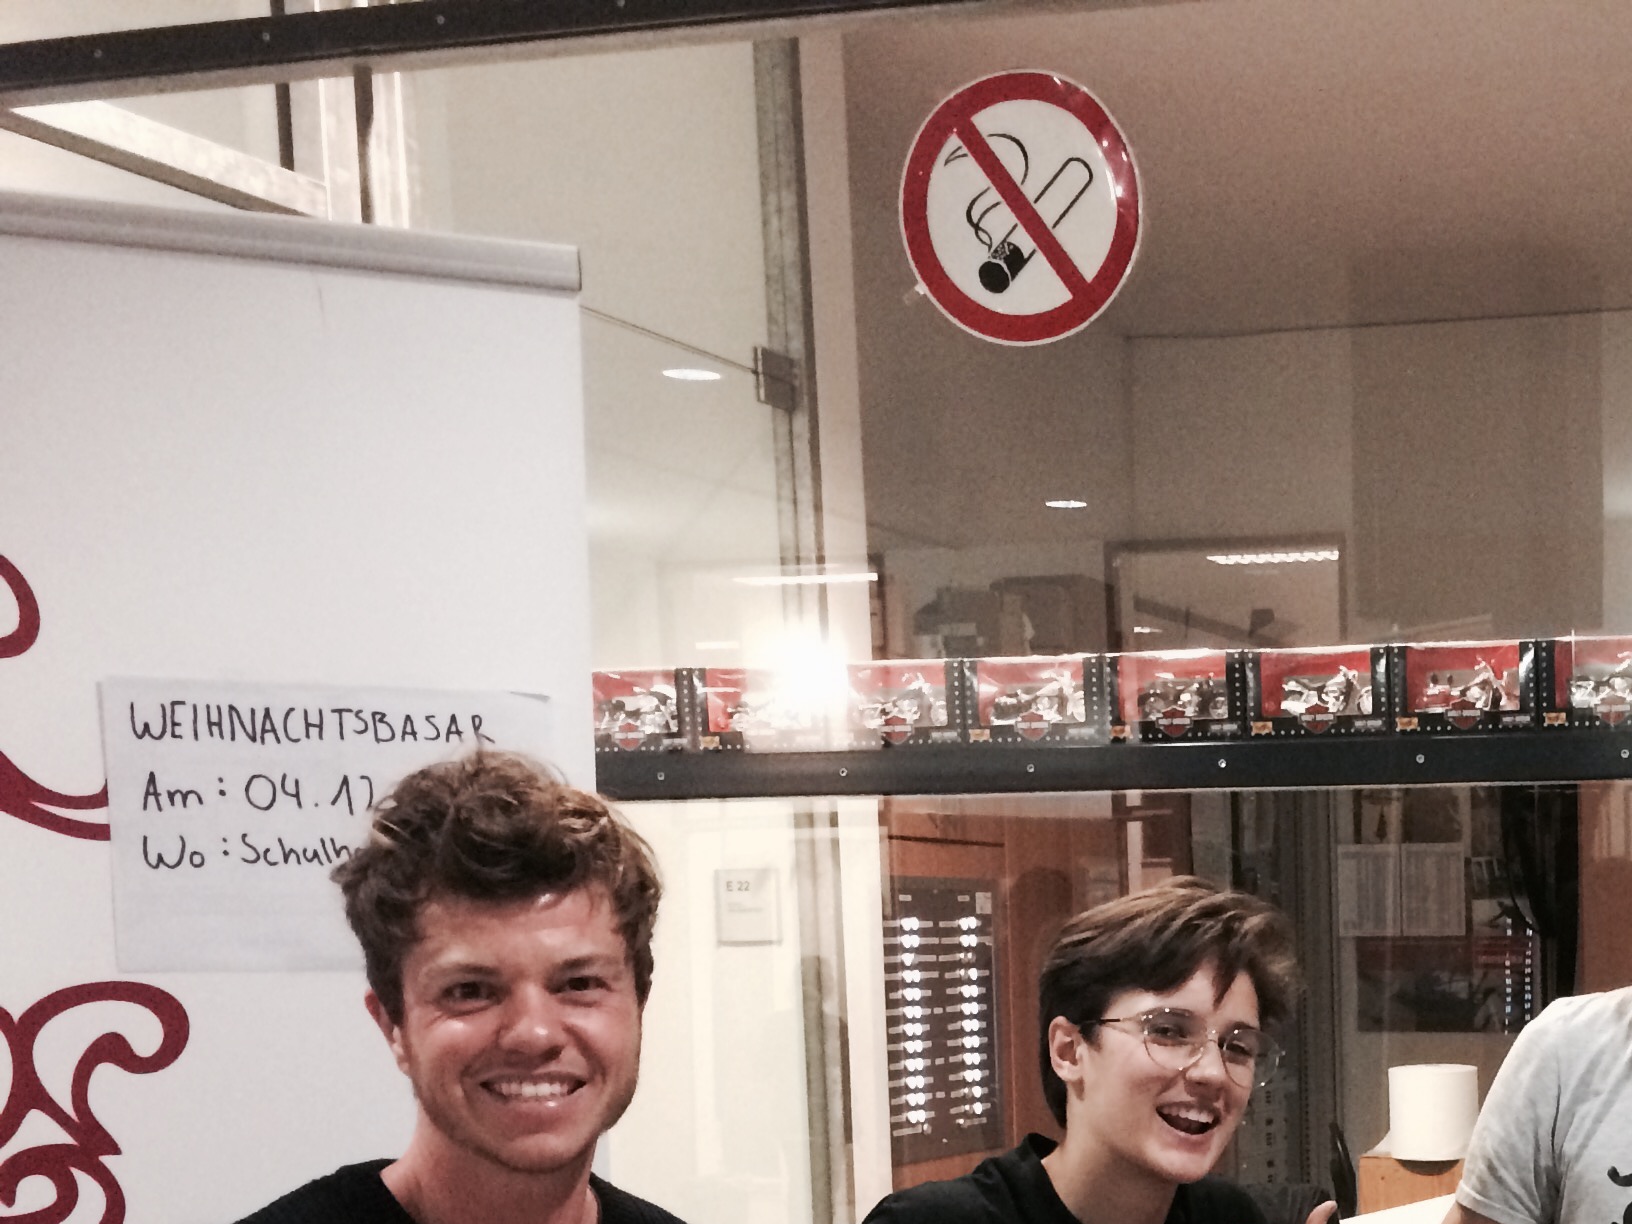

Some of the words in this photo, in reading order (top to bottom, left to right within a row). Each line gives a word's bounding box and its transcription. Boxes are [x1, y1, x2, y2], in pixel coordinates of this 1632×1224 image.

[130, 700, 496, 745] WEIHNACHTSBASAR
[241, 832, 356, 867] Schulh
[726, 880, 734, 892] E
[737, 880, 751, 892] 22
